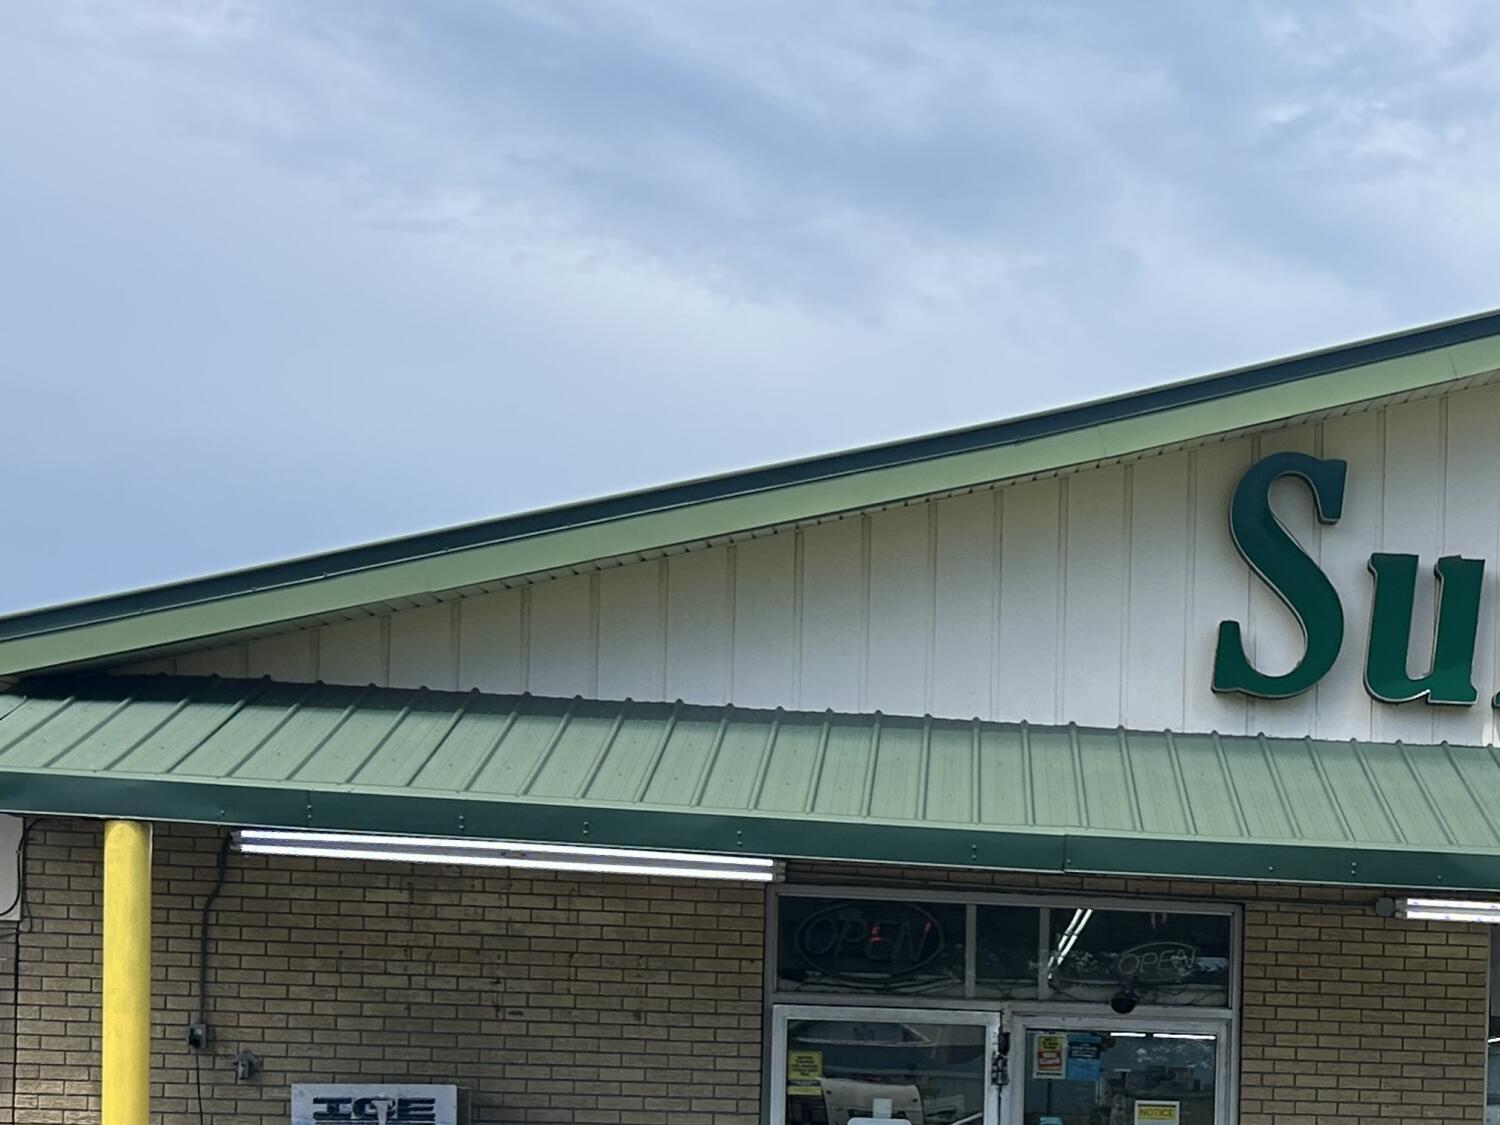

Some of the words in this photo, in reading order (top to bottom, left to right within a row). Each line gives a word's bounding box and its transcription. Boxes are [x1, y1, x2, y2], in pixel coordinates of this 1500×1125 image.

[805, 918, 932, 961] OPEN
[1118, 950, 1196, 977] OPEN
[313, 1097, 435, 1121] ICE
[1138, 1108, 1176, 1118] NOTICE
